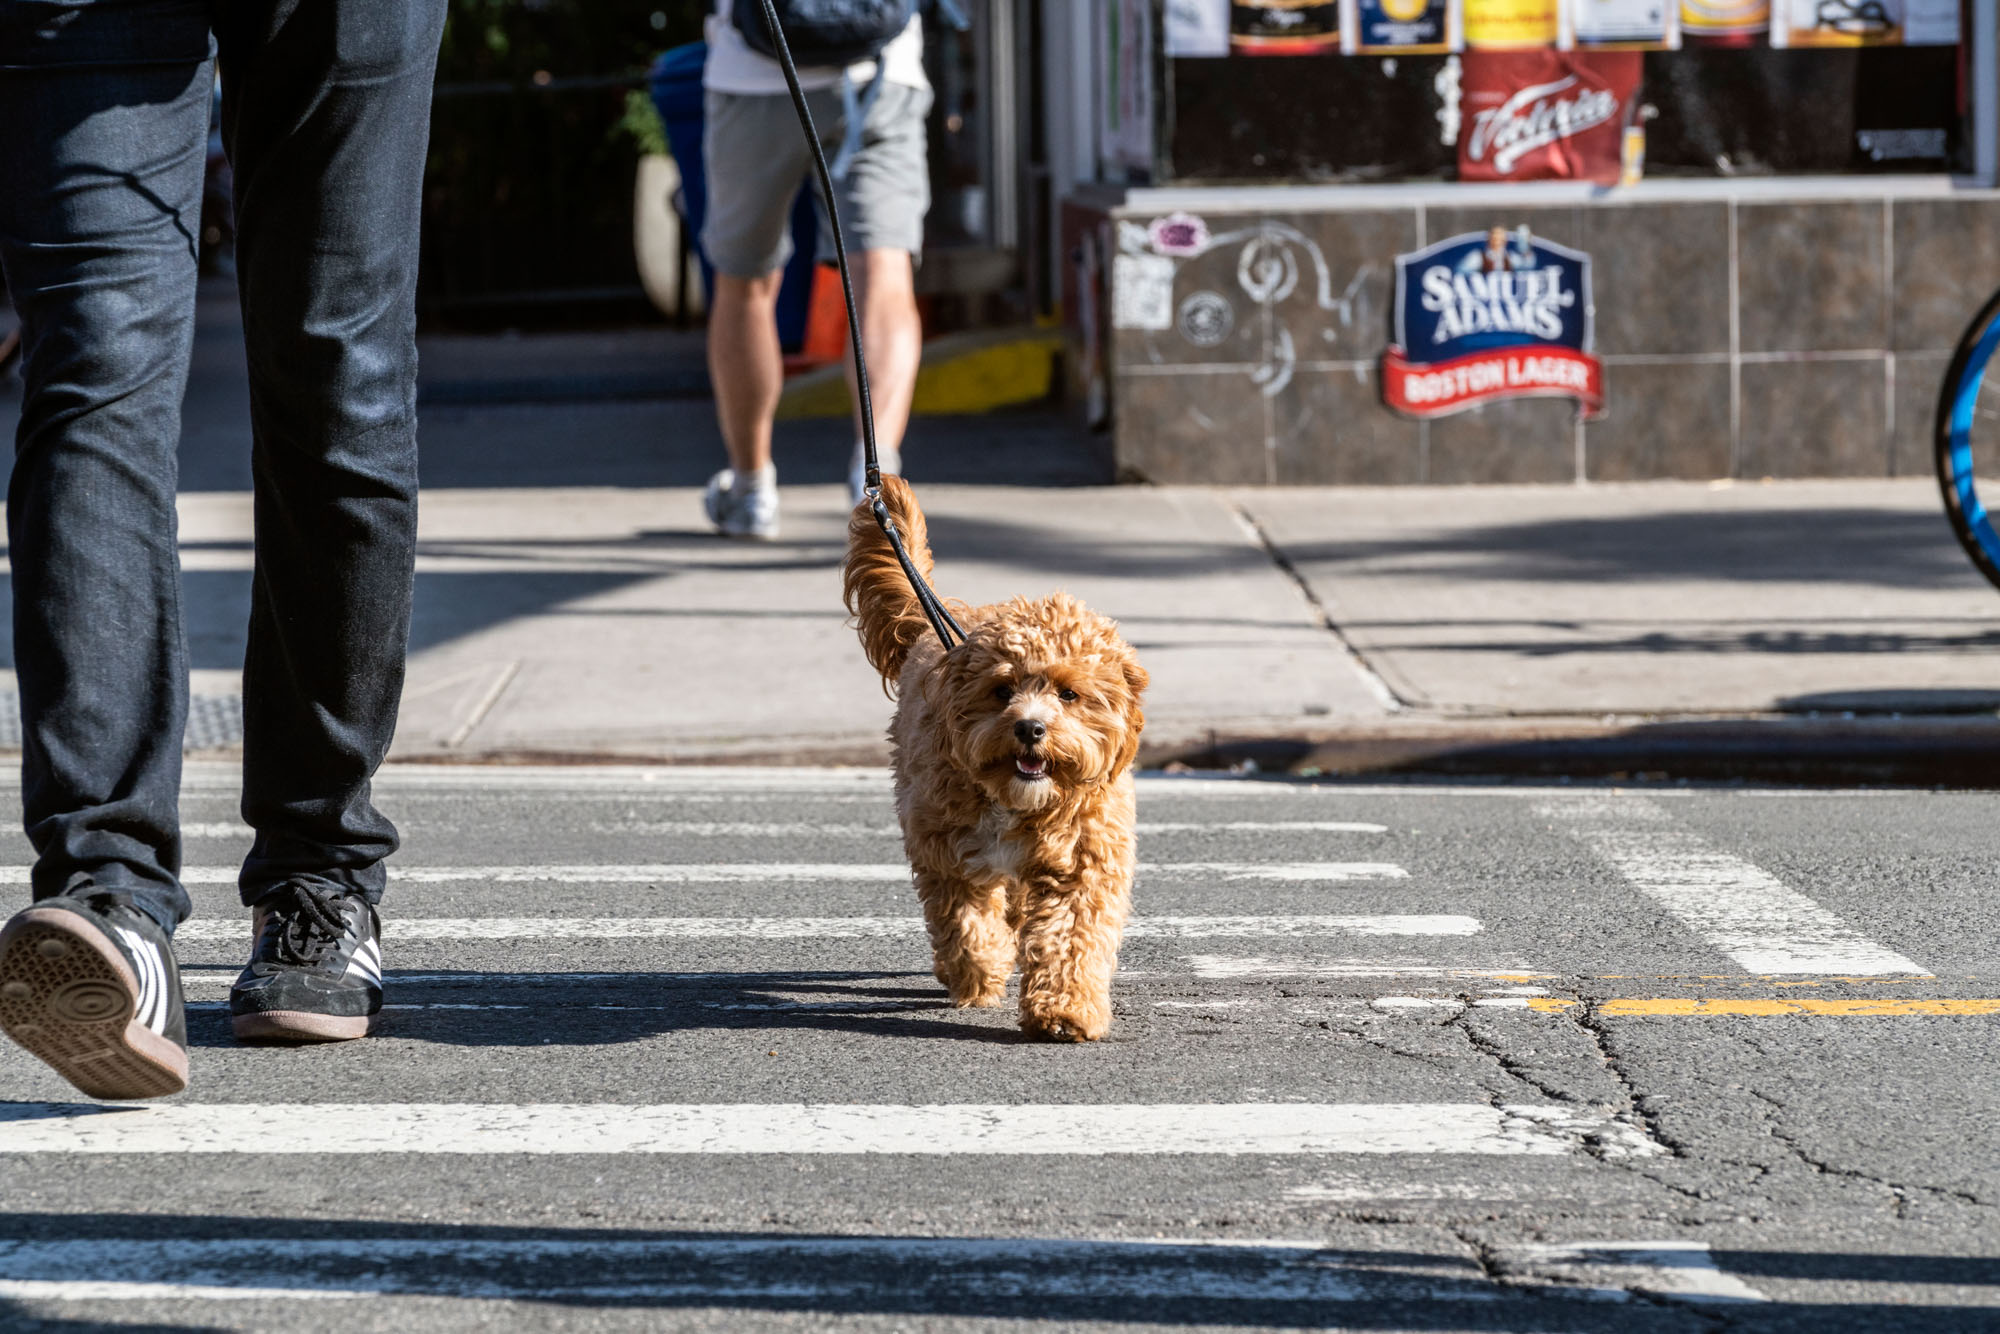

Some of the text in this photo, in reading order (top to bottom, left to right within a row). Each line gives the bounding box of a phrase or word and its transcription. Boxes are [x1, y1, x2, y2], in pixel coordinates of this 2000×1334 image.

[1421, 264, 1575, 312] SAMUEL
[1432, 298, 1564, 344] ADAMS
[1404, 355, 1589, 403] BOSTON LAGER
